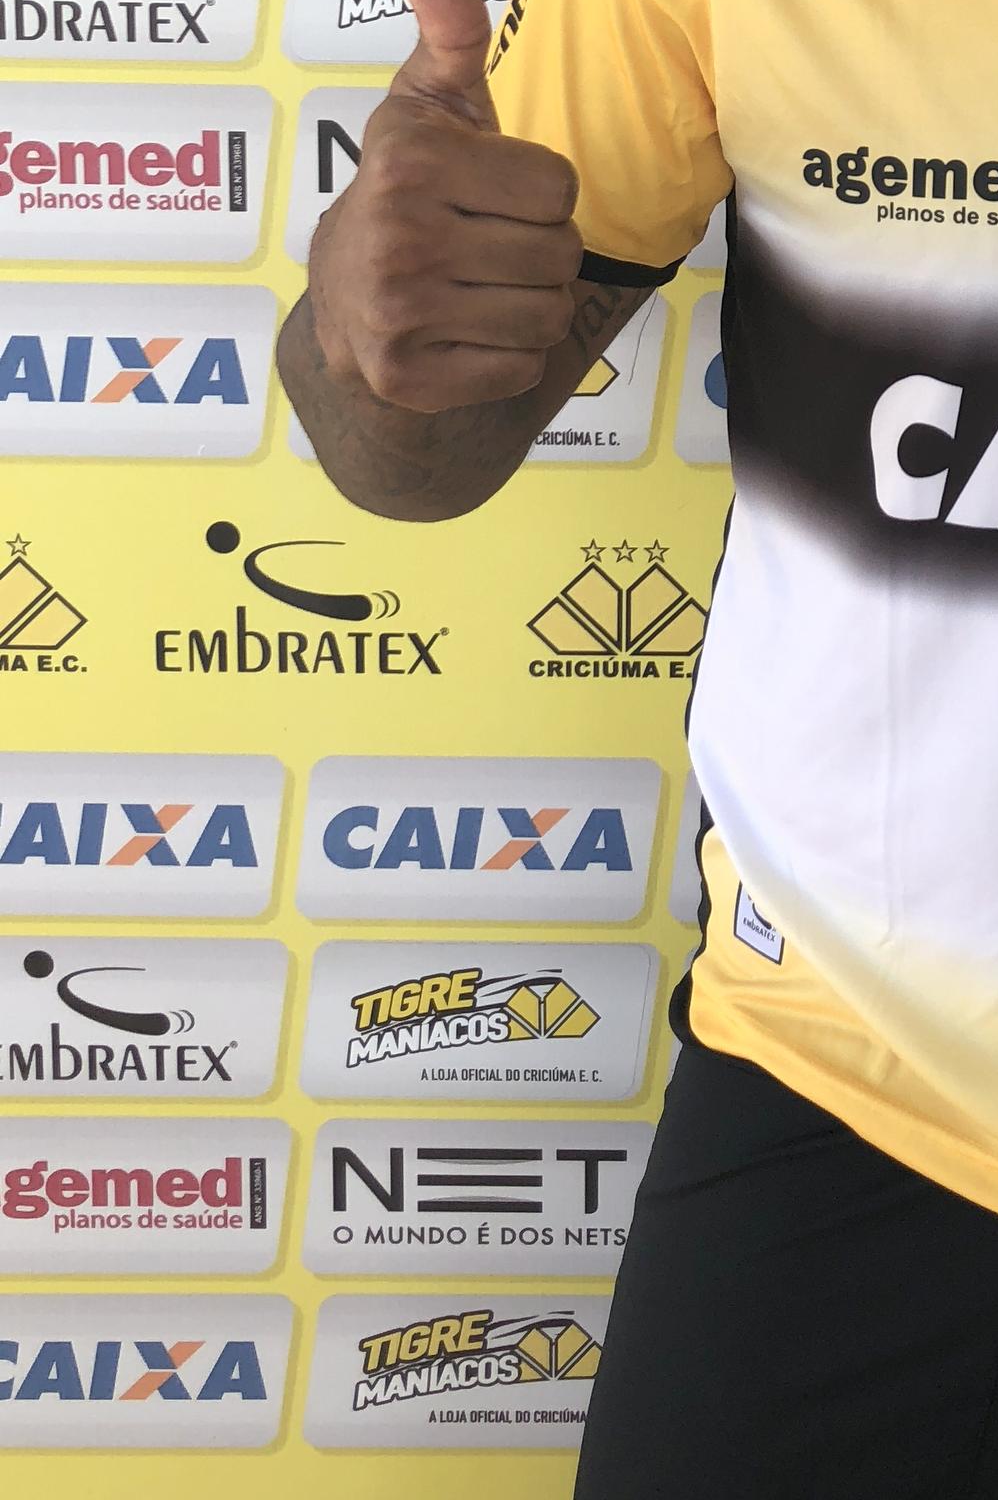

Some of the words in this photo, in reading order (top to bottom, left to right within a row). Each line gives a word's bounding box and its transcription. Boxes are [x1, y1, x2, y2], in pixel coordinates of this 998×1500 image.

[0, 130, 221, 196] emed
[20, 187, 103, 213] planos
[109, 189, 141, 210] de
[147, 189, 222, 211] saúde
[876, 201, 945, 225] planos
[952, 204, 979, 226] de
[0, 335, 249, 405] AIXA
[37, 655, 87, 672] E.C.
[529, 657, 660, 678] CRICIÚMA
[0, 802, 258, 867] AIXA
[323, 805, 633, 871] CAIXA
[351, 968, 481, 1032] TIGRE
[346, 1010, 509, 1068] MANÍACOS
[432, 1069, 458, 1081] LOJA
[462, 1069, 502, 1081] OFICIAL
[506, 1069, 520, 1081] DO
[524, 1067, 576, 1082] CRICIÚMA
[2, 1157, 243, 1219] gemed
[332, 1148, 627, 1215] NET
[55, 1210, 132, 1233] planos
[138, 1210, 167, 1228] de
[173, 1209, 243, 1229] saúde
[333, 1225, 353, 1244] O
[365, 1226, 466, 1245] MUNDO
[477, 1223, 491, 1246] É
[501, 1227, 553, 1246] DOS
[565, 1227, 627, 1247] NETS
[0, 1341, 267, 1401] AIXA
[359, 1310, 493, 1376] TIGRE
[353, 1353, 520, 1411] MANÍACOS
[440, 1411, 467, 1423] LOJA
[470, 1411, 511, 1423] OFICIAL
[515, 1411, 530, 1423] DO
